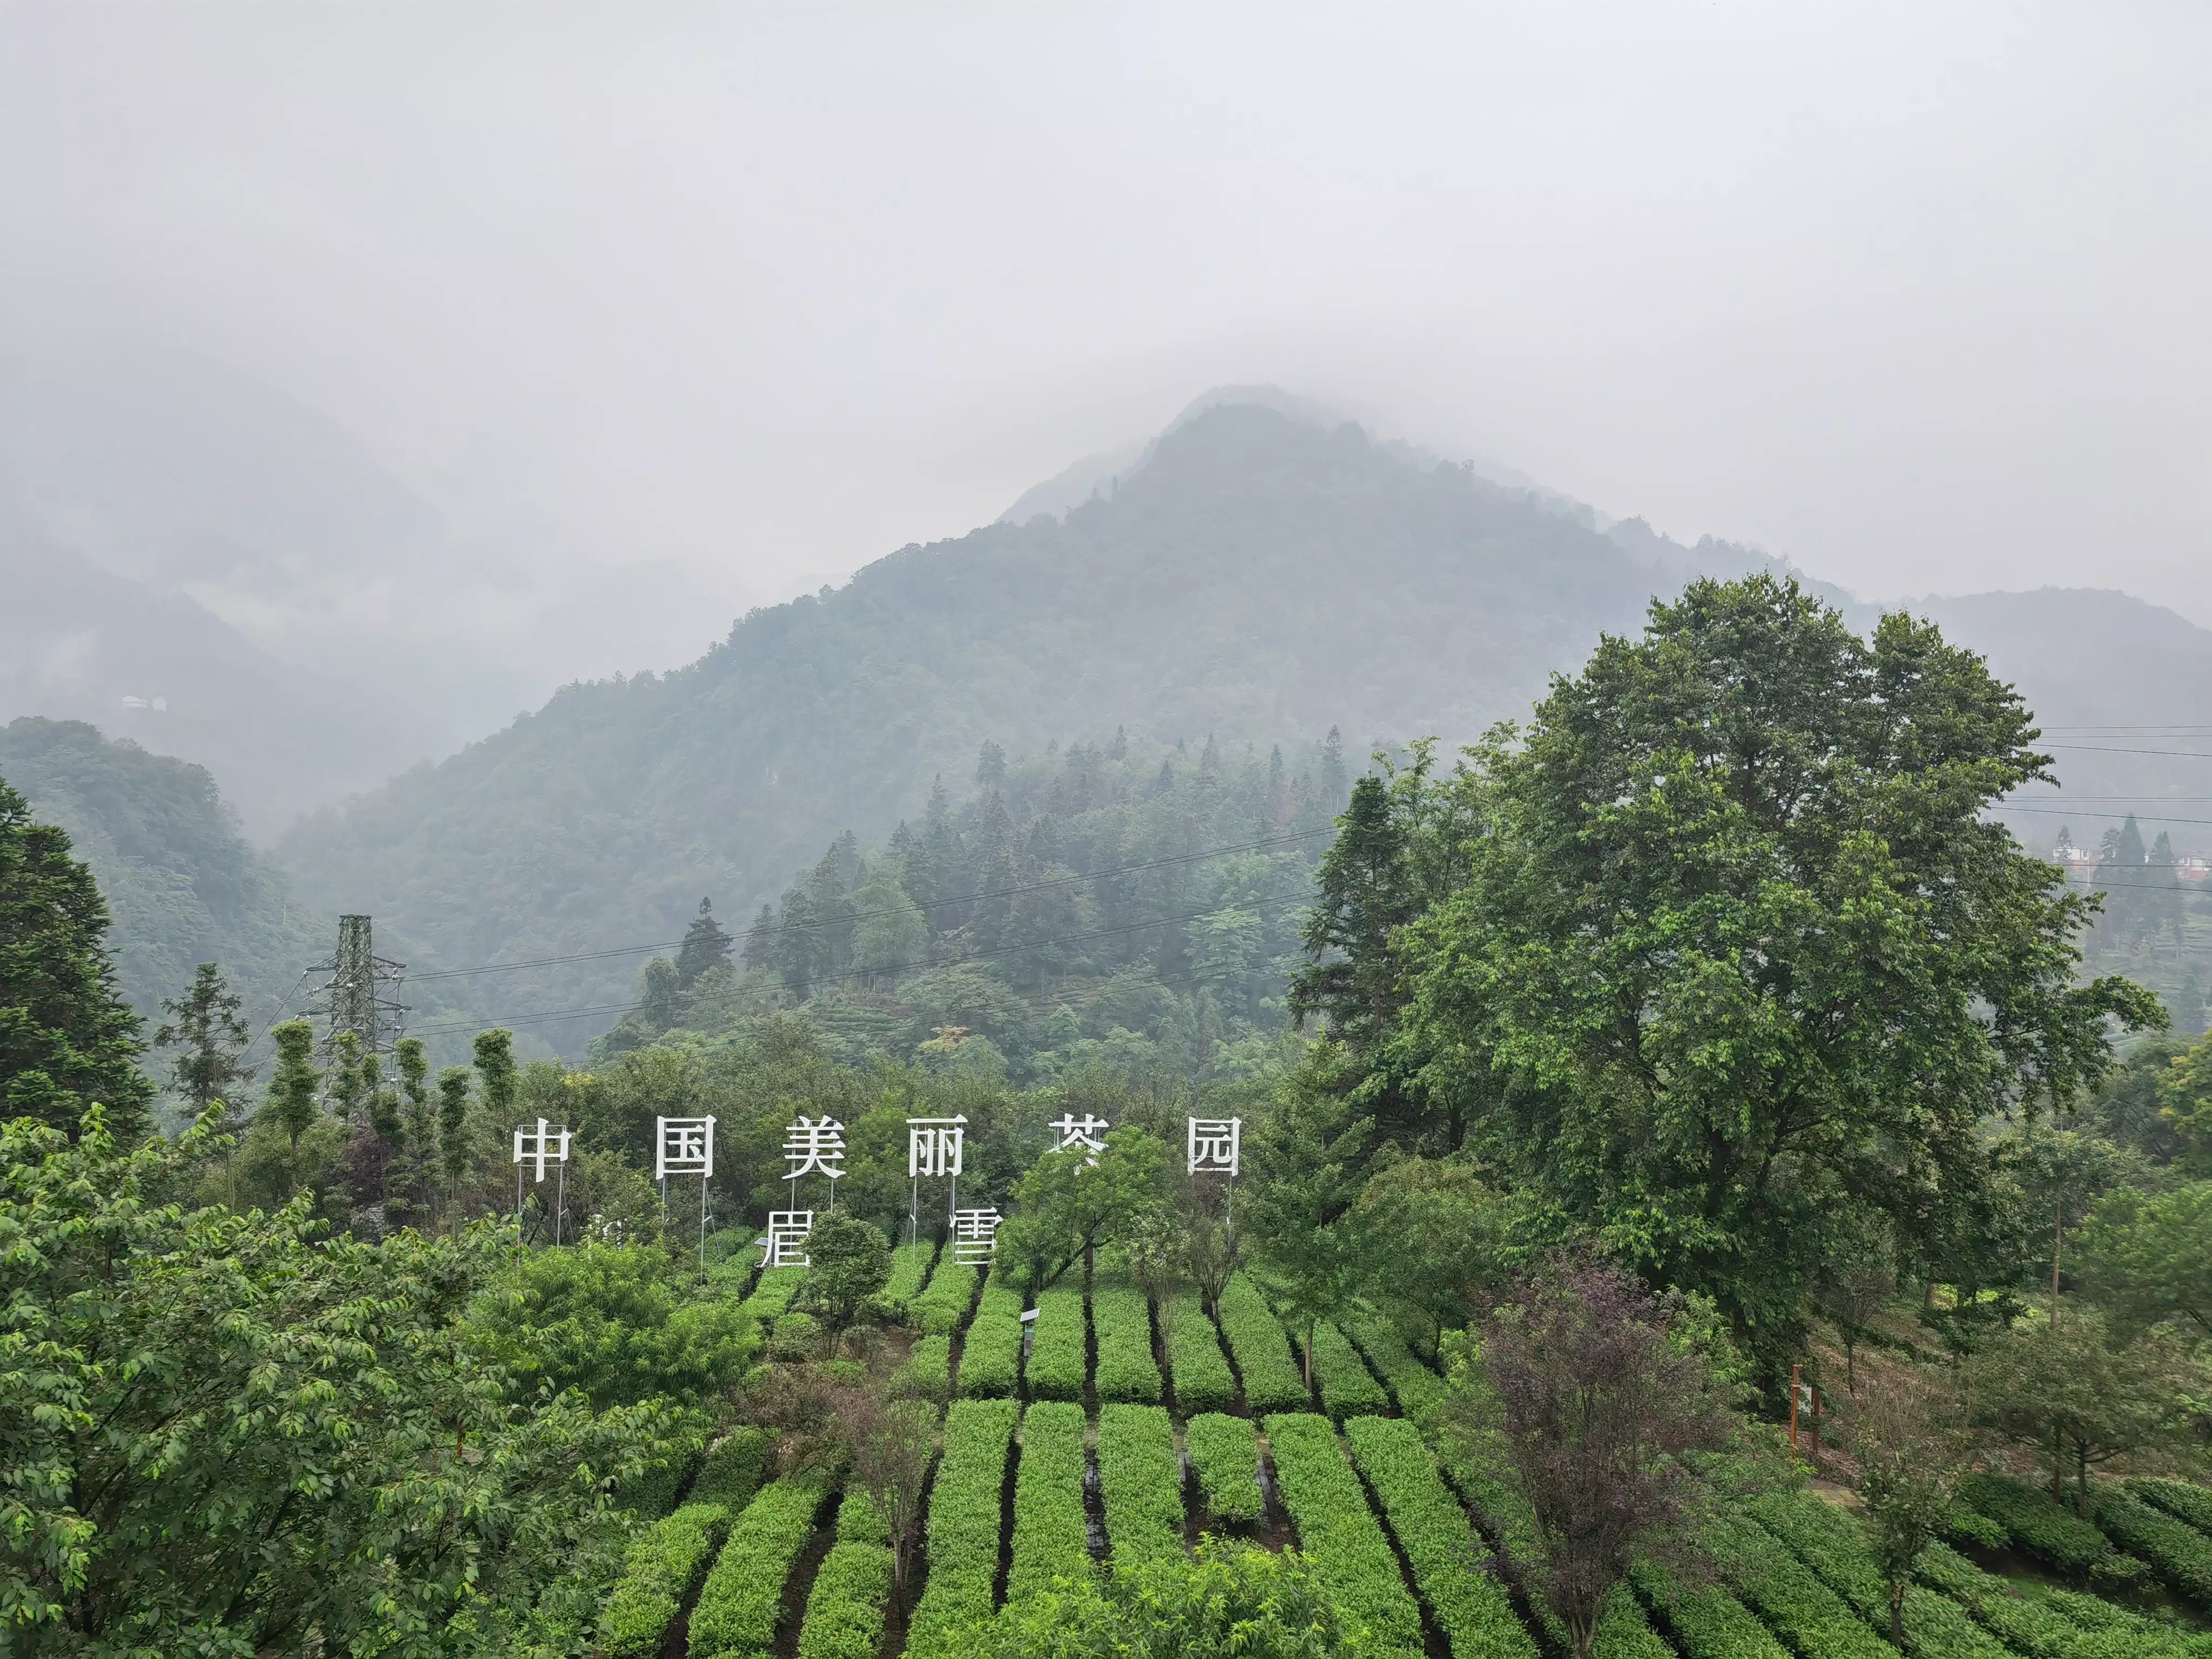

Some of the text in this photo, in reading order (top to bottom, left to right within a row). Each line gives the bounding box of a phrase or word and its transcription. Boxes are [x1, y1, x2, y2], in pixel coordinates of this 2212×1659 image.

[513, 1113, 1242, 1183] 中国美丽茶园
[587, 1207, 1003, 1267] 眉雪
